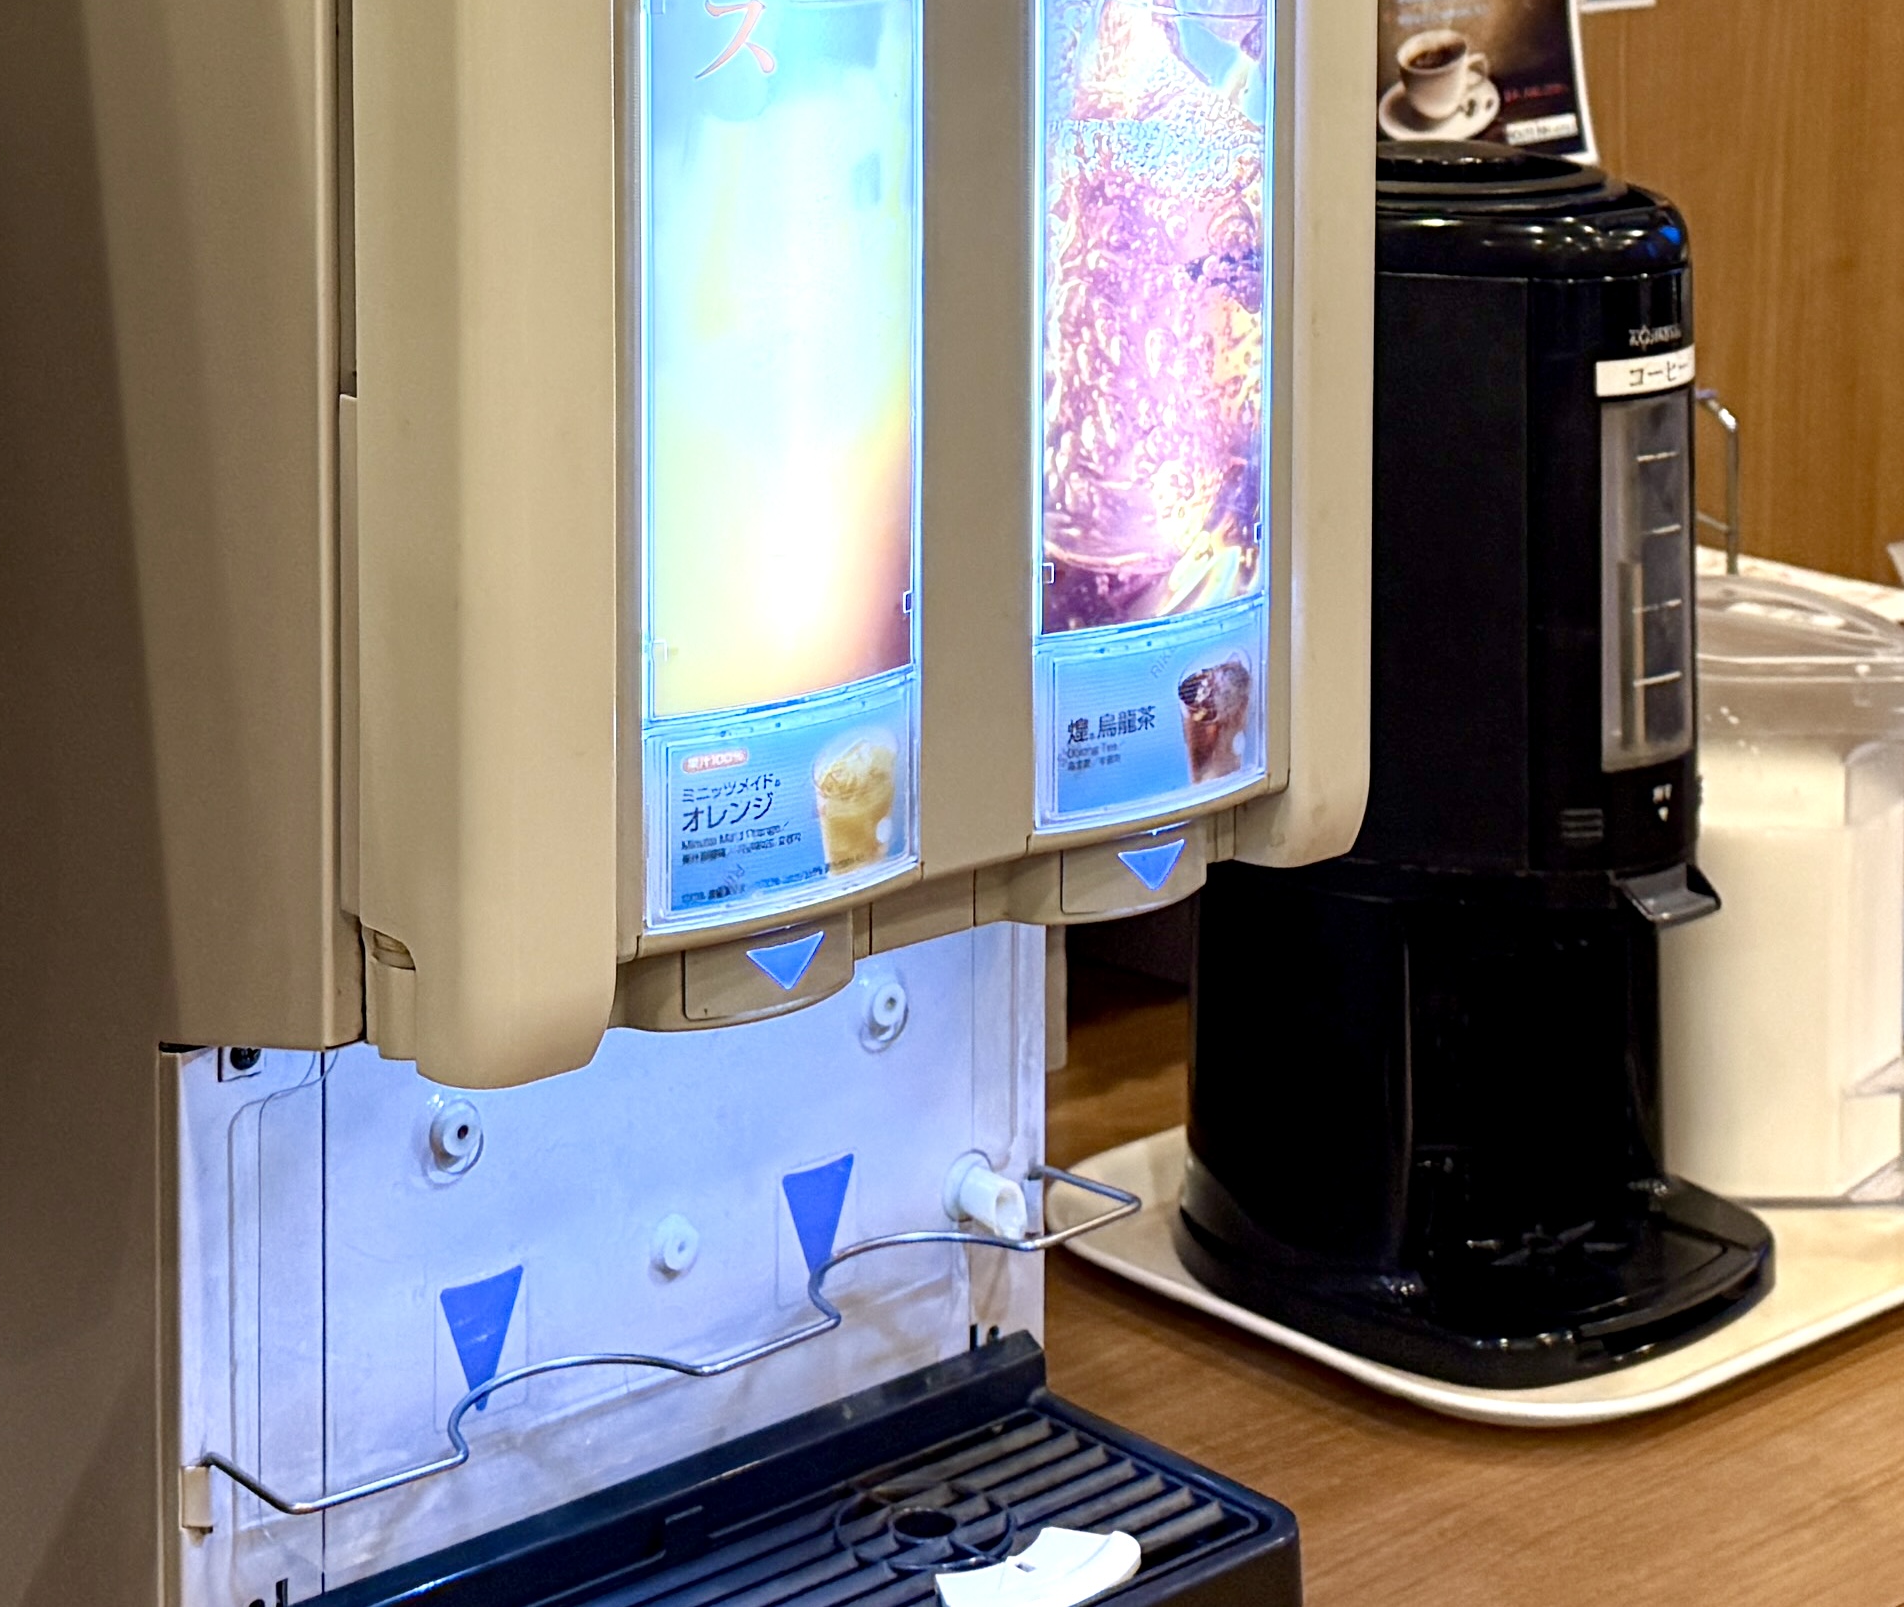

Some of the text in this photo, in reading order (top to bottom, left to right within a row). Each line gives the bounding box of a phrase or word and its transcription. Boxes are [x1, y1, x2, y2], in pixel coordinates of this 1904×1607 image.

[1629, 360, 1689, 387] コーヒー
[682, 791, 774, 833] オレンジ
